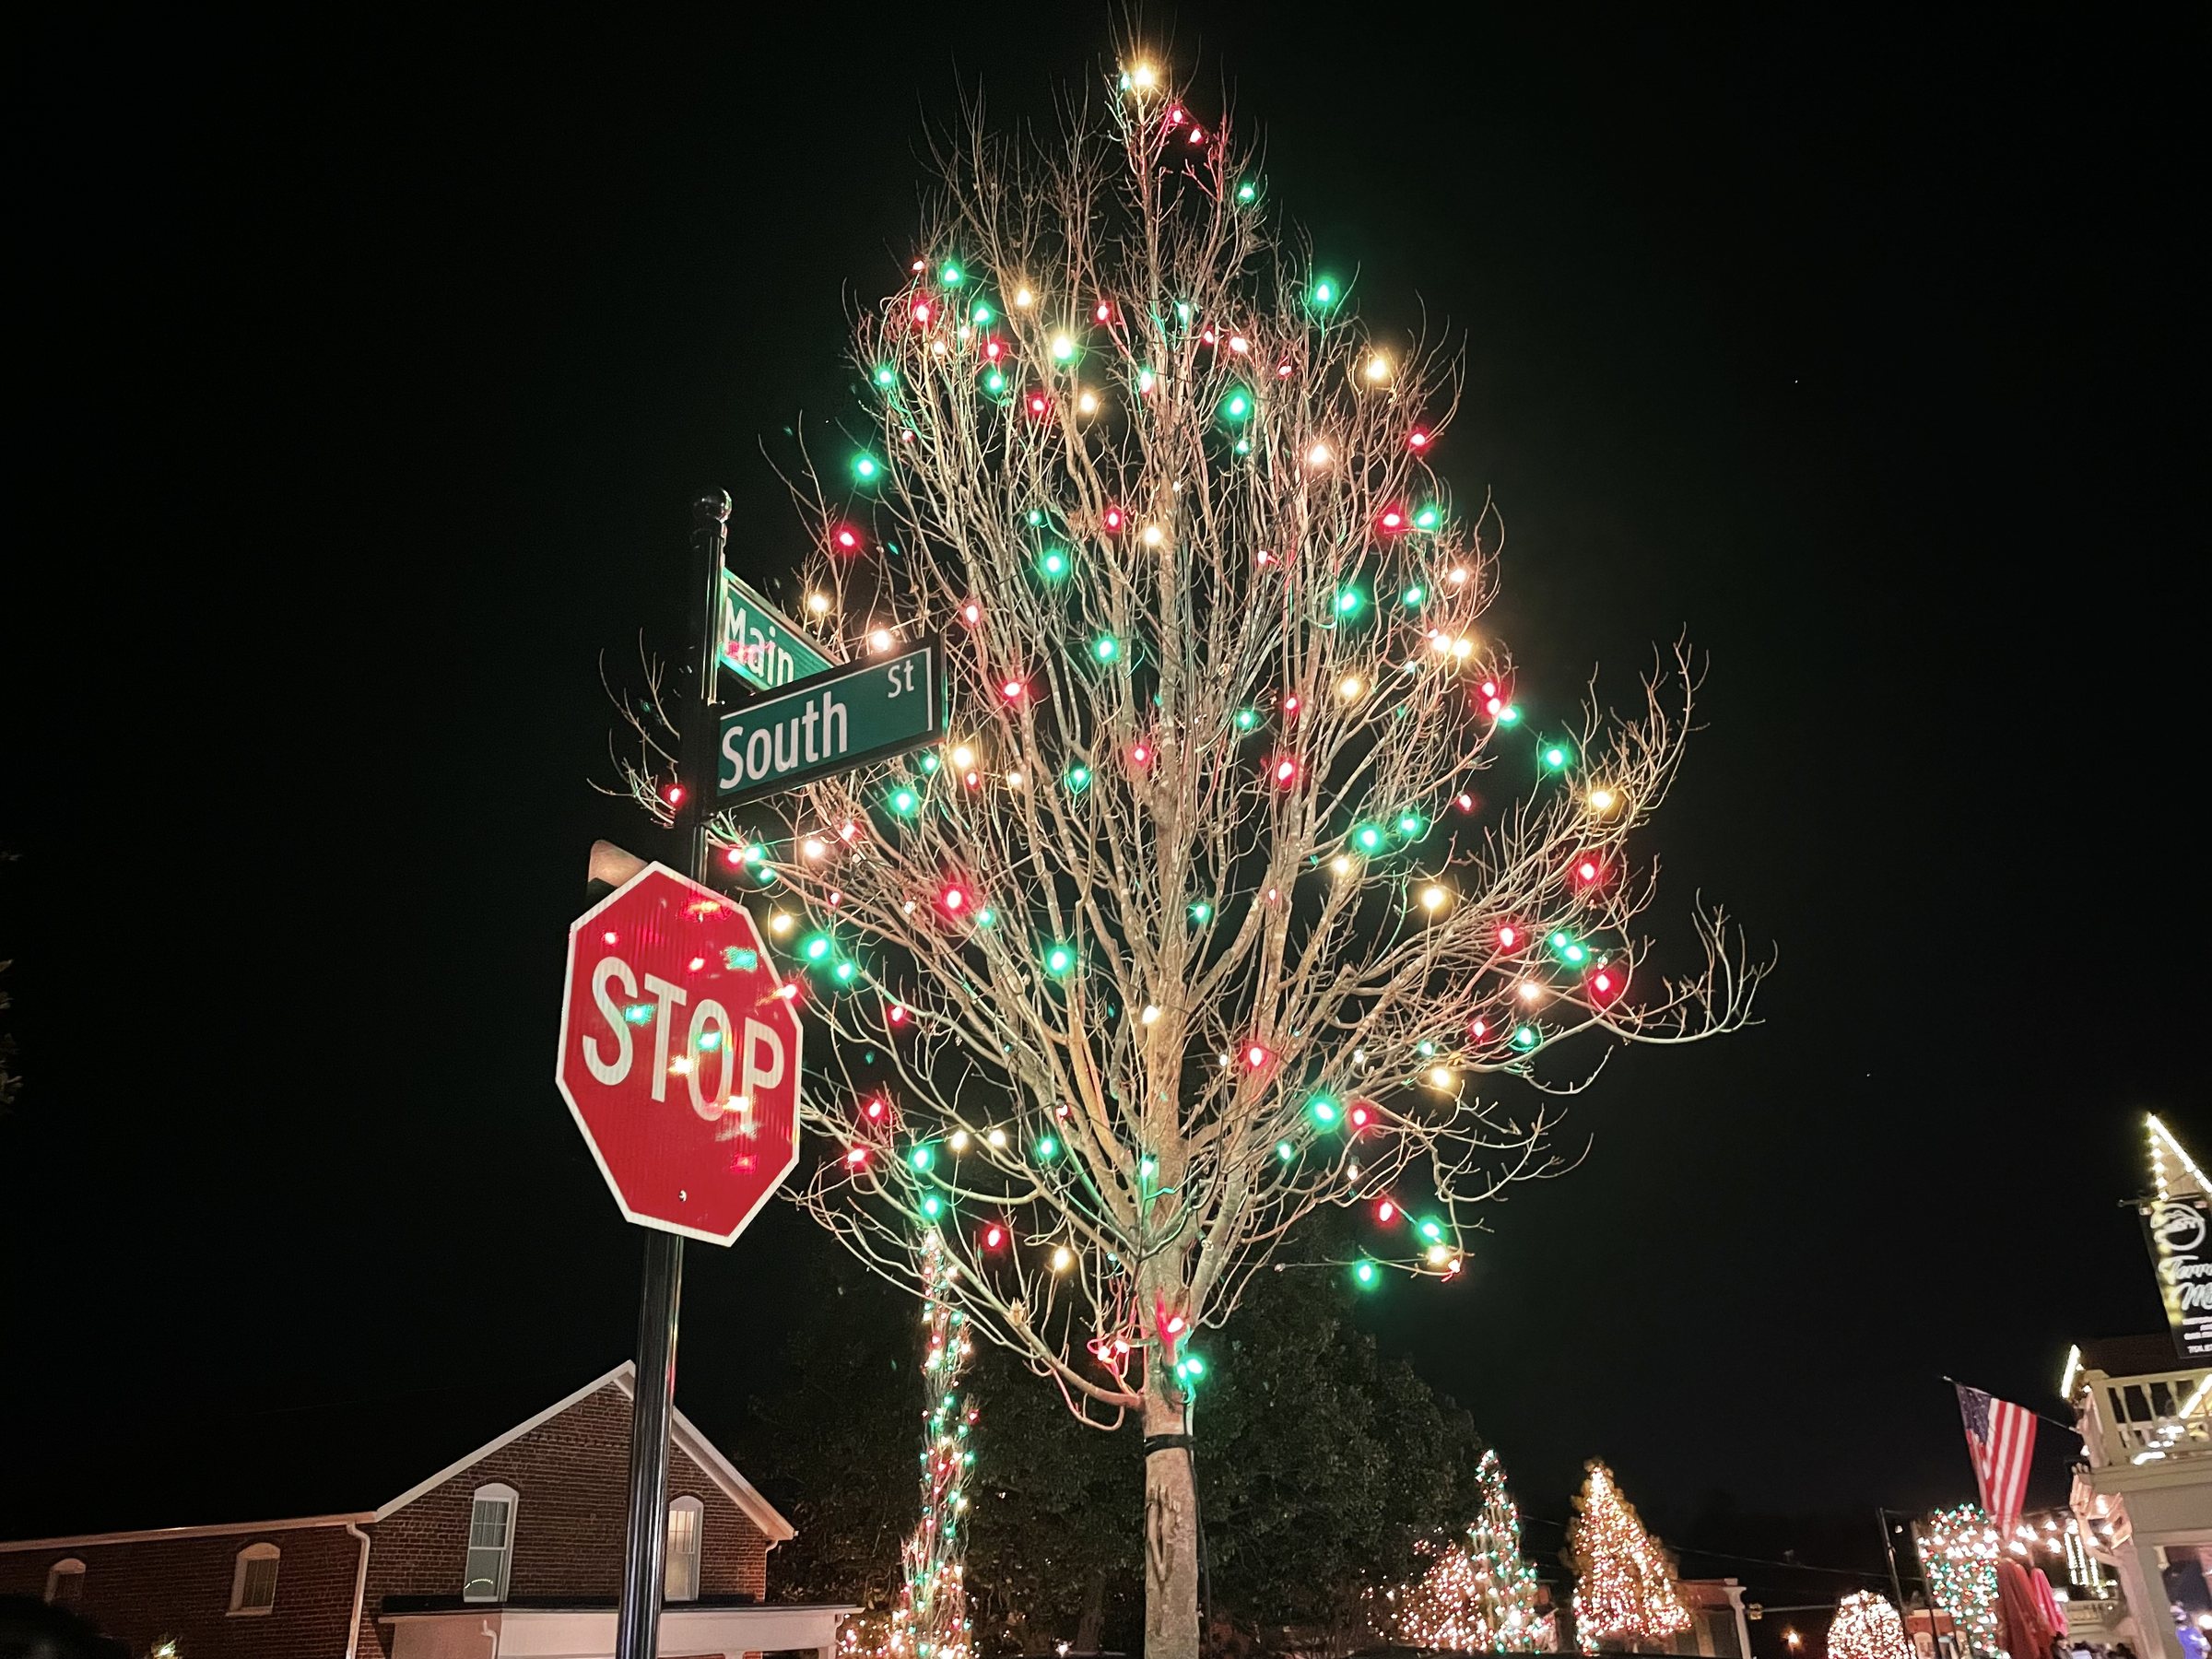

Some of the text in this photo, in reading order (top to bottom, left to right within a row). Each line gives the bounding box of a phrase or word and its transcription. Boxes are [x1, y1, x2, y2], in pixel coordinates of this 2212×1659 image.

[724, 596, 794, 686] Main
[719, 660, 915, 790] South St
[582, 957, 784, 1137] STOP
